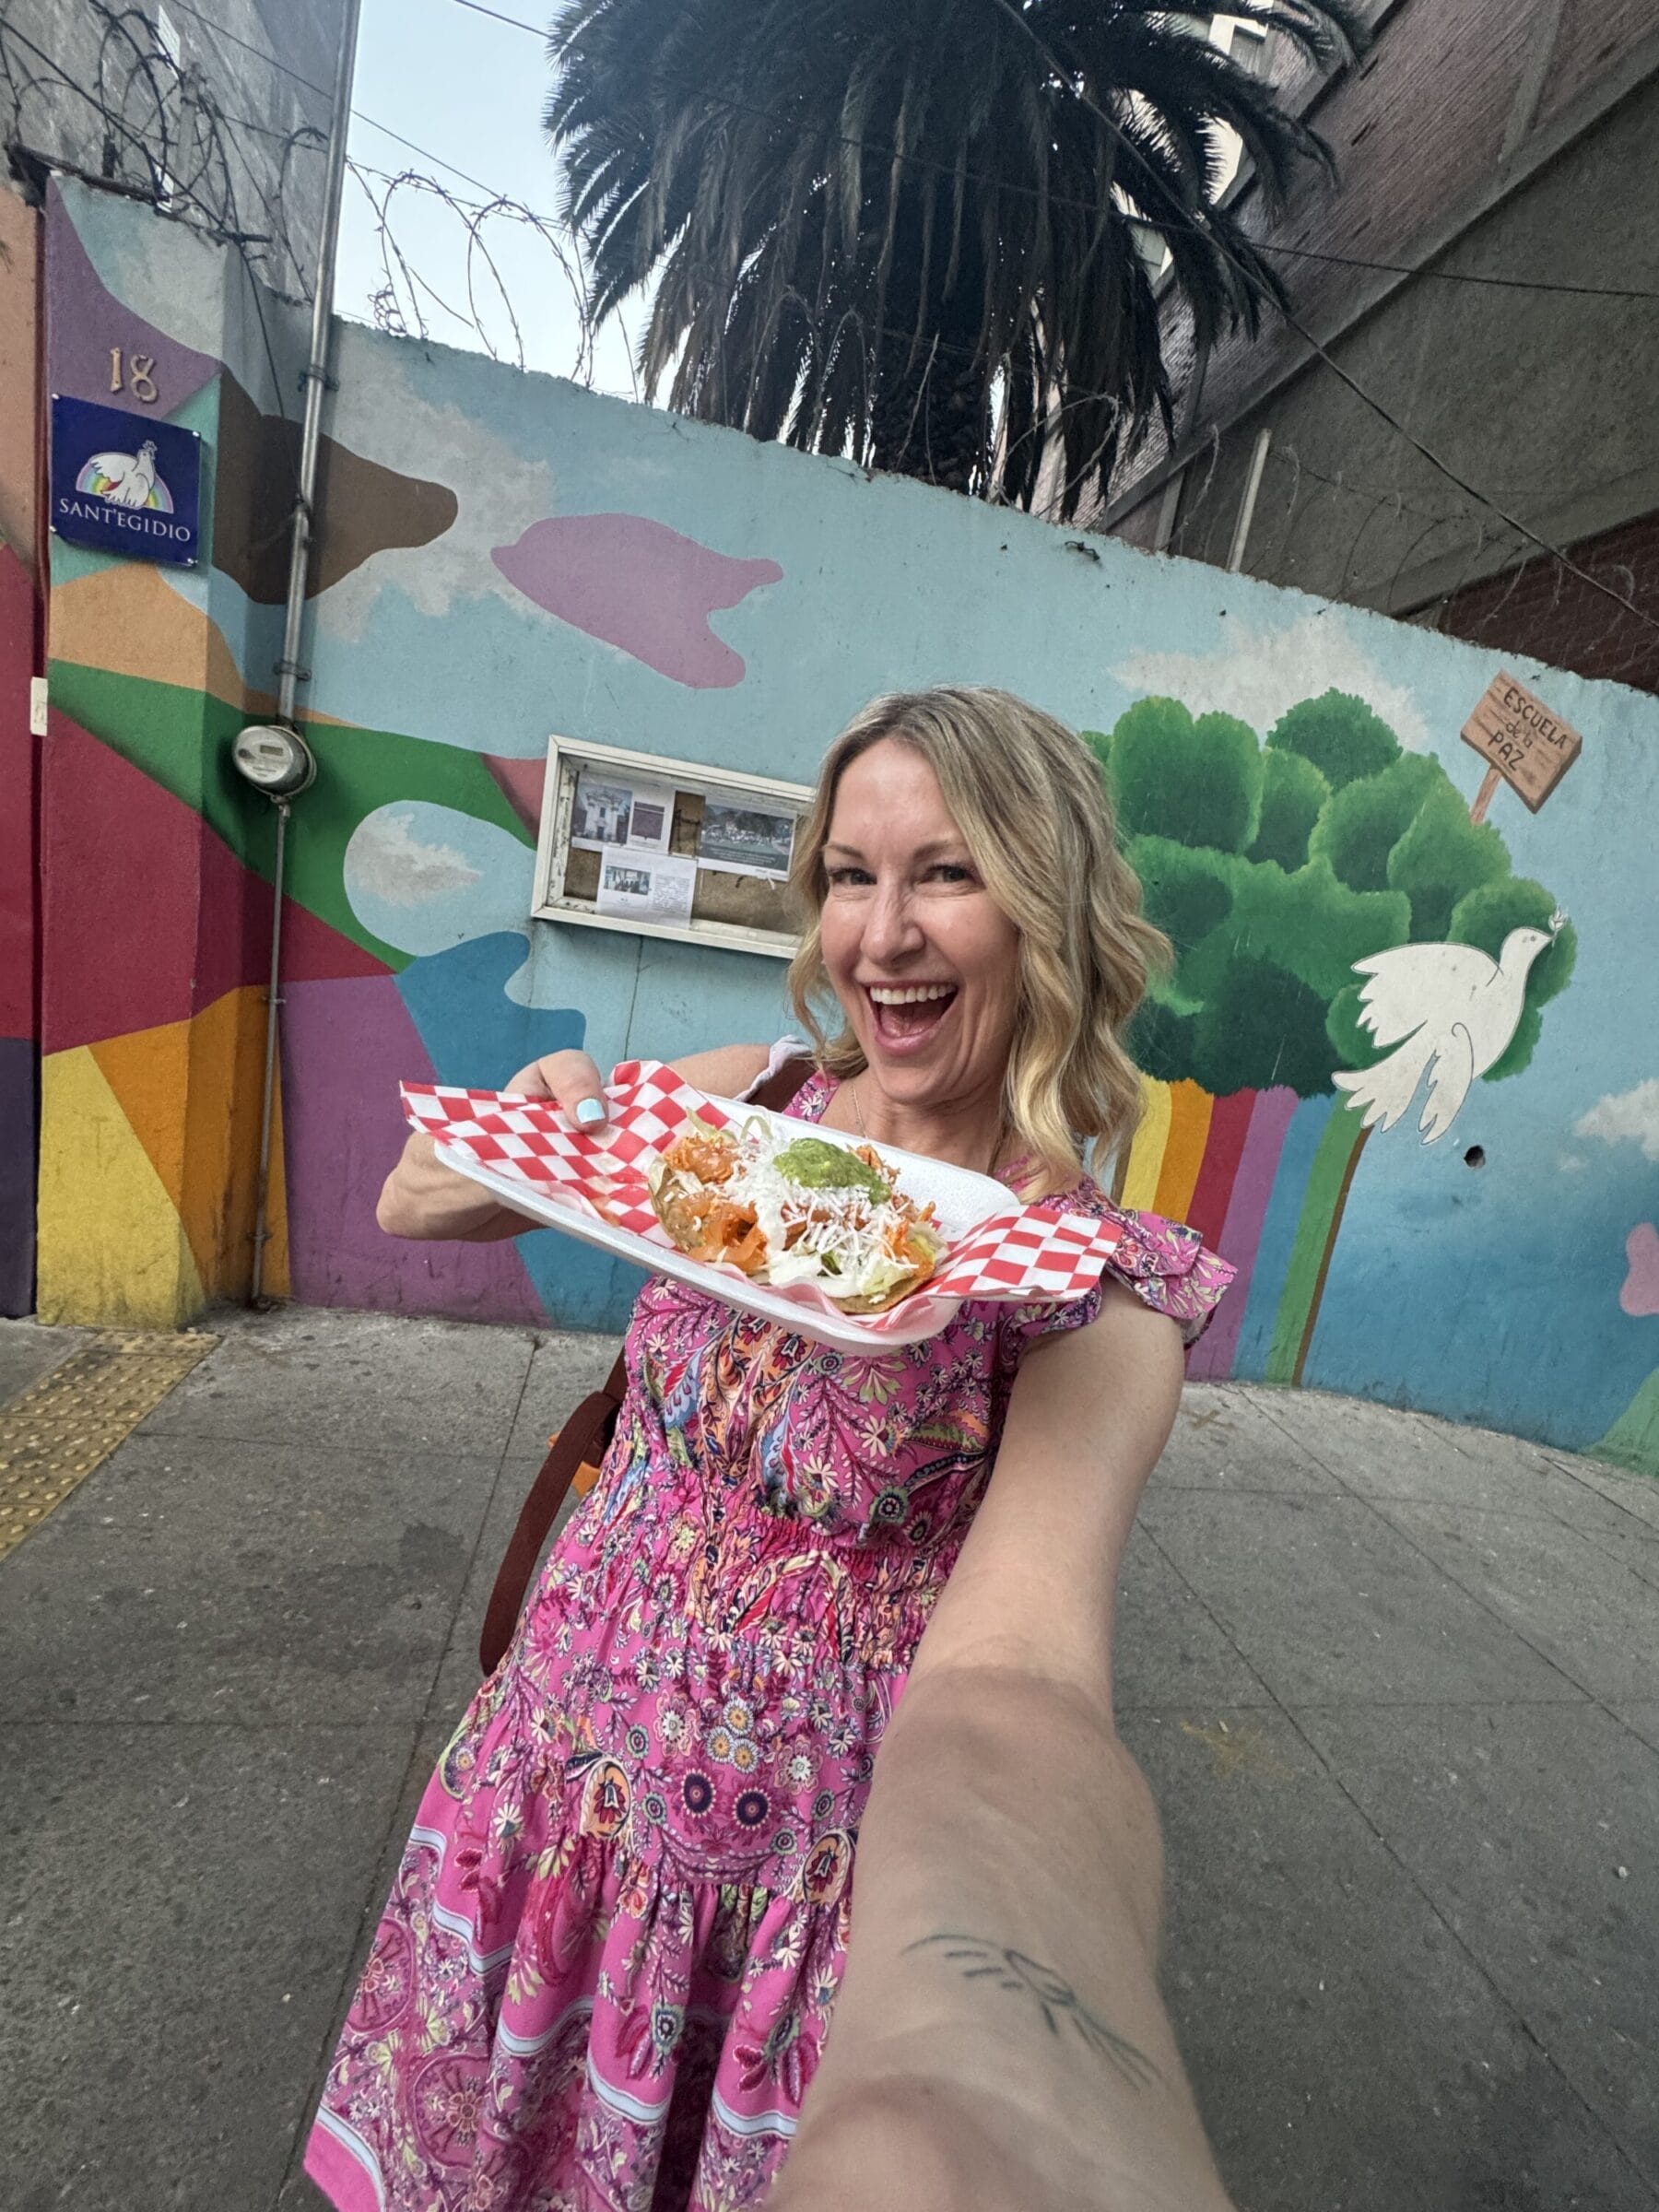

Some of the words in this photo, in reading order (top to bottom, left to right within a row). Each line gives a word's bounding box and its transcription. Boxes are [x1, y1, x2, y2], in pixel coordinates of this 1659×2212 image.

[110, 347, 159, 403] 18
[59, 498, 191, 542] SANT'EGIDIO
[1503, 687, 1567, 749] ESCUELA
[1505, 721, 1521, 738] de
[1488, 731, 1524, 771] PAZ
